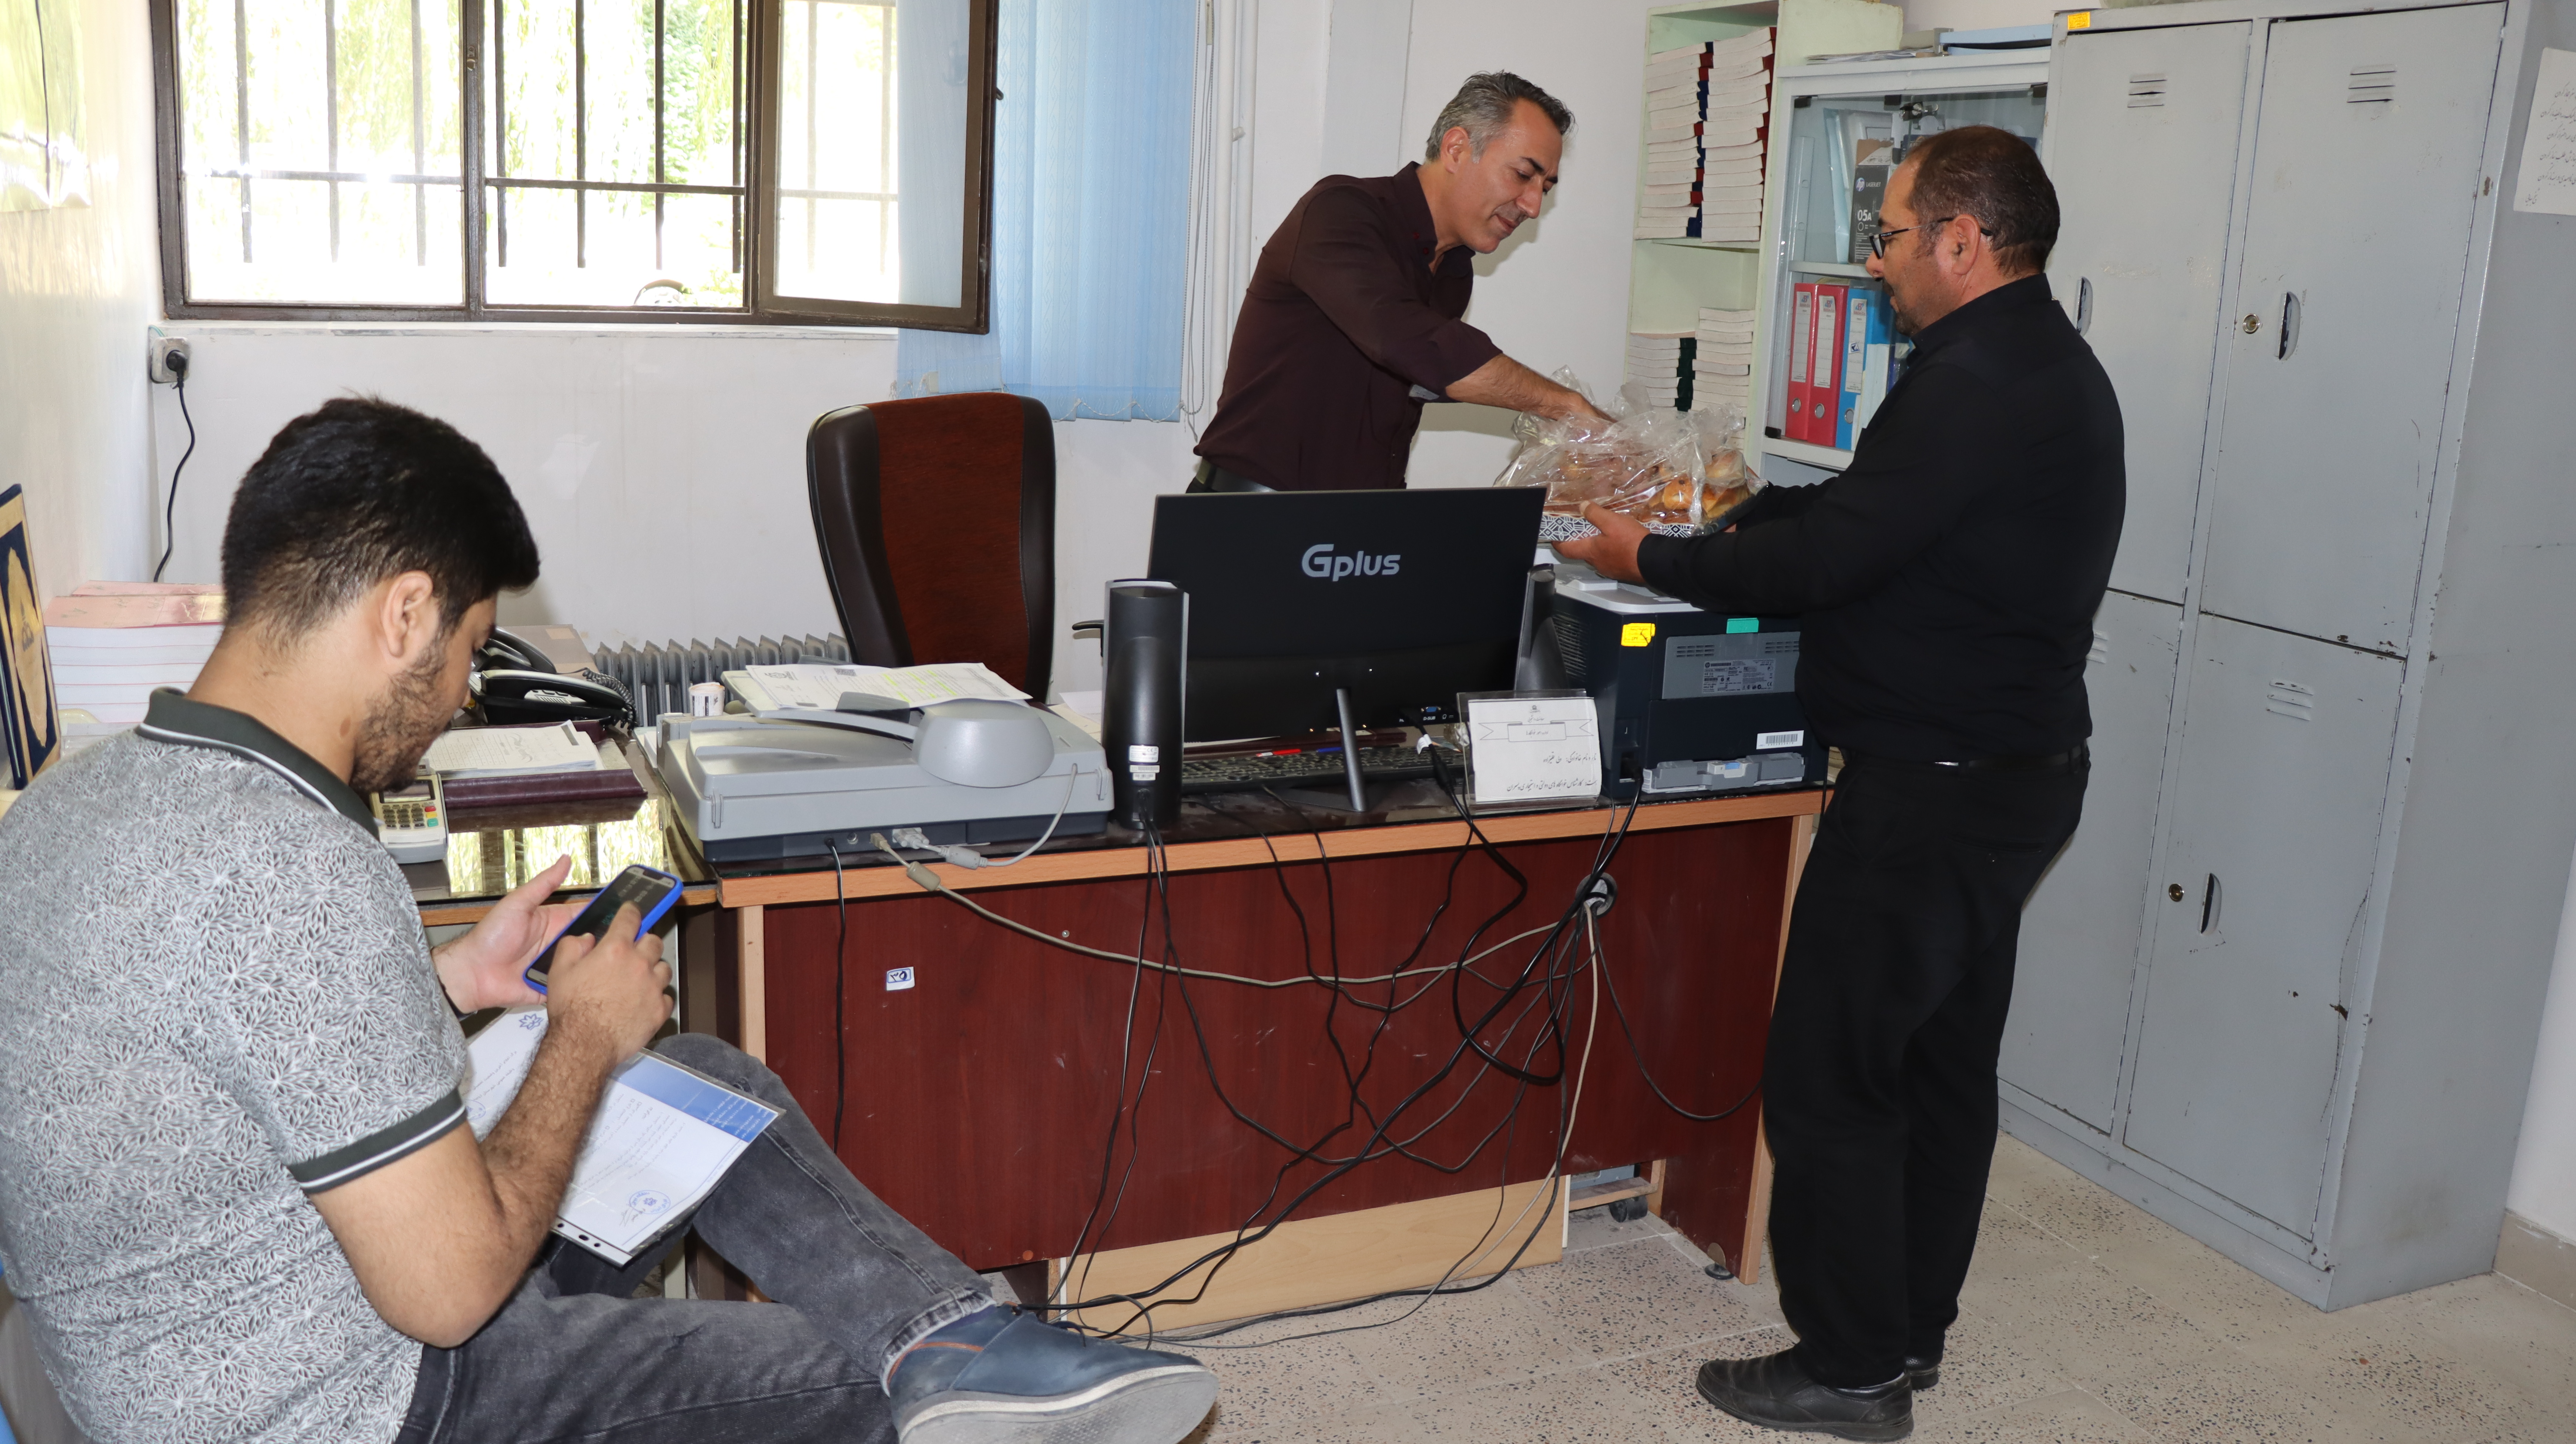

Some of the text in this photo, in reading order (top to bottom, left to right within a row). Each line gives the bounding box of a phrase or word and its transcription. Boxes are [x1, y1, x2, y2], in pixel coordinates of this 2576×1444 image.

[1856, 177, 1865, 192] hp
[1858, 209, 1872, 221] 05A
[1302, 544, 1401, 582] Gplus
